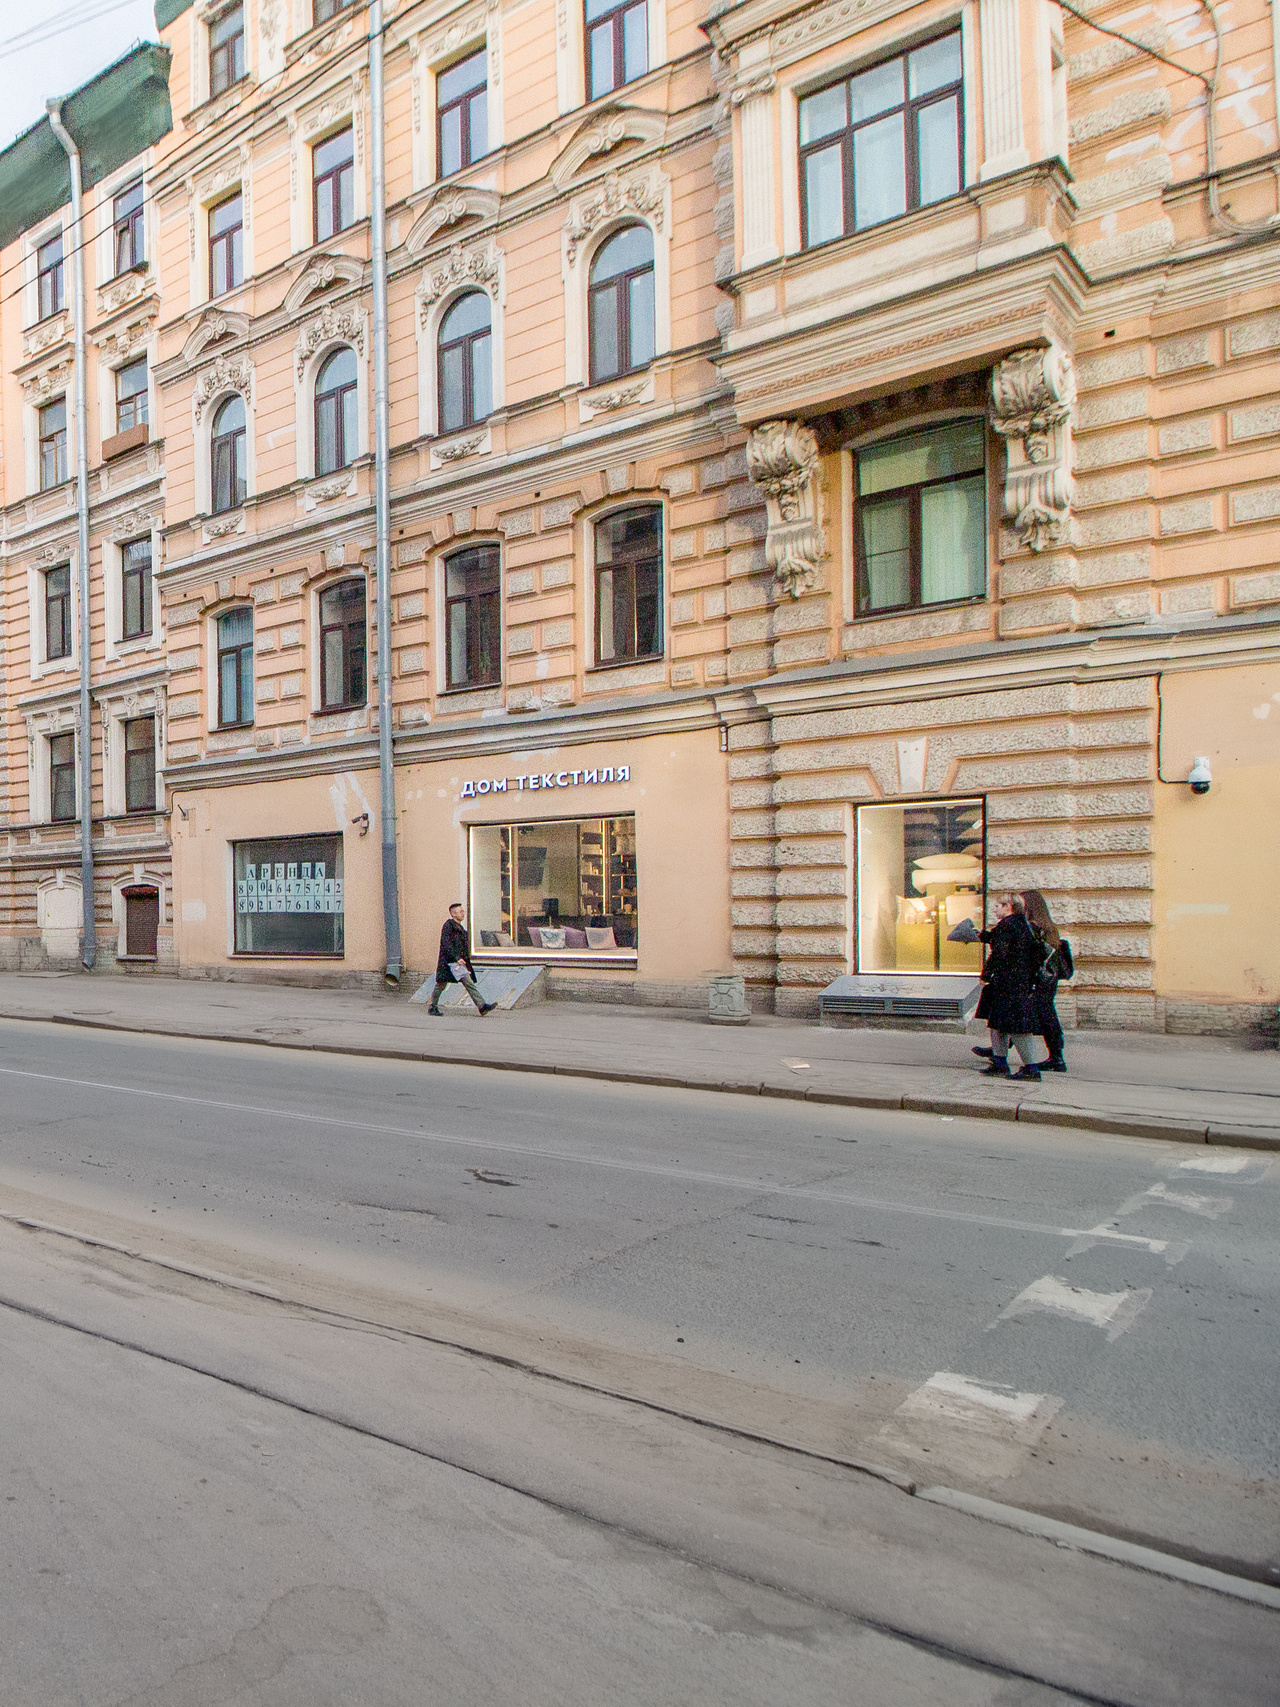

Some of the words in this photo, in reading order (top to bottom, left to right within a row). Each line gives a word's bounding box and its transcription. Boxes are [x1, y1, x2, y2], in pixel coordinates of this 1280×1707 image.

[460, 777, 508, 798] ДОМ
[515, 765, 631, 791] ТЕКСТИЛЯ
[247, 867, 324, 879] АРЕНДА
[238, 882, 341, 894] 89046475742
[239, 900, 341, 911] 89217761817
